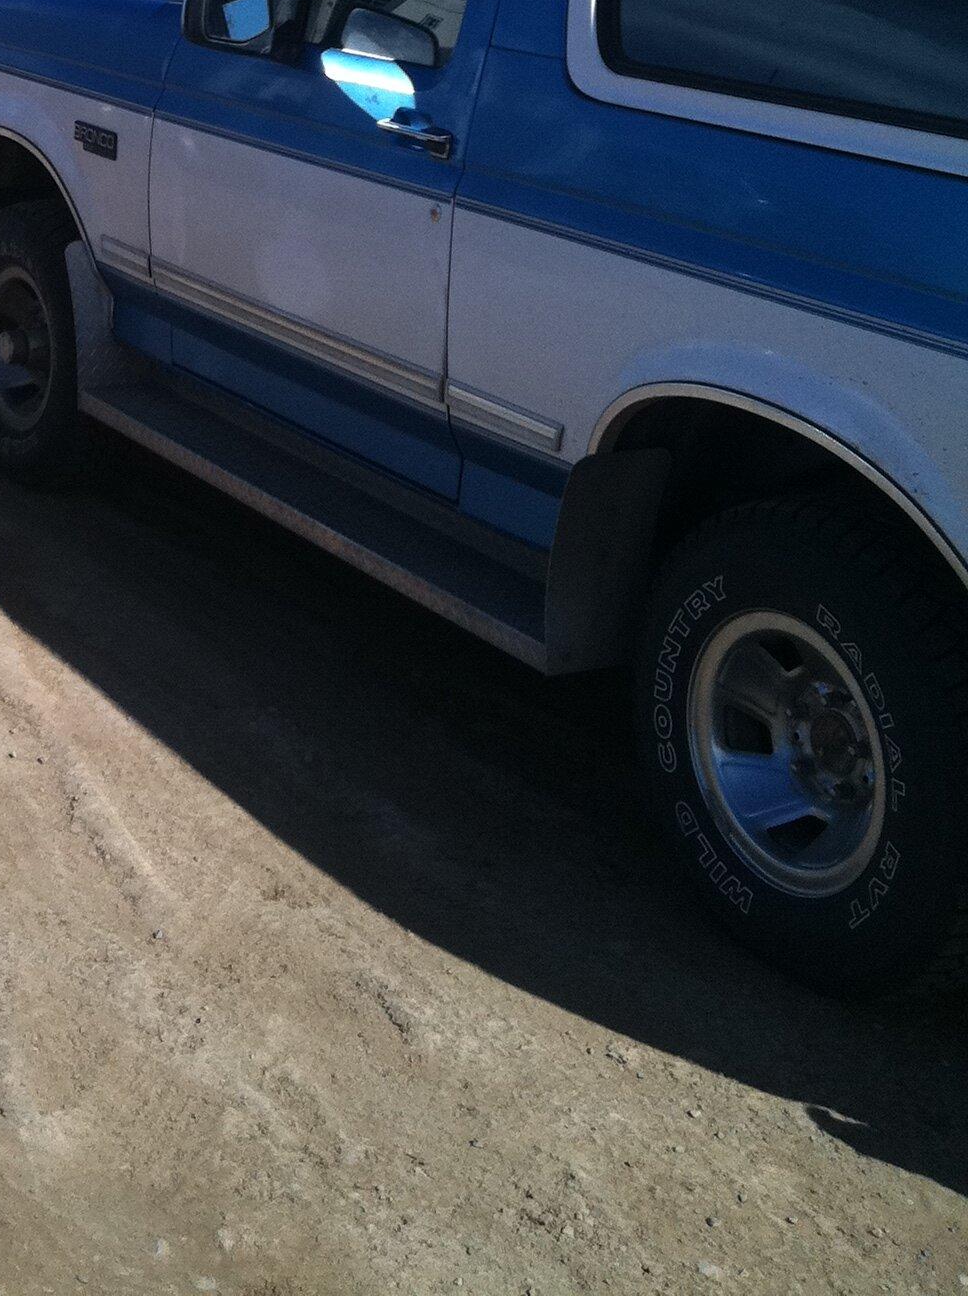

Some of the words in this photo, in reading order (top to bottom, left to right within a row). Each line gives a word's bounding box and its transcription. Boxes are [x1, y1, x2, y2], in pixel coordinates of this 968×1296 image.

[654, 575, 727, 773] COUNTRY
[816, 604, 907, 812] RADIAL
[675, 801, 755, 914] WILD
[848, 840, 902, 930] RVT
